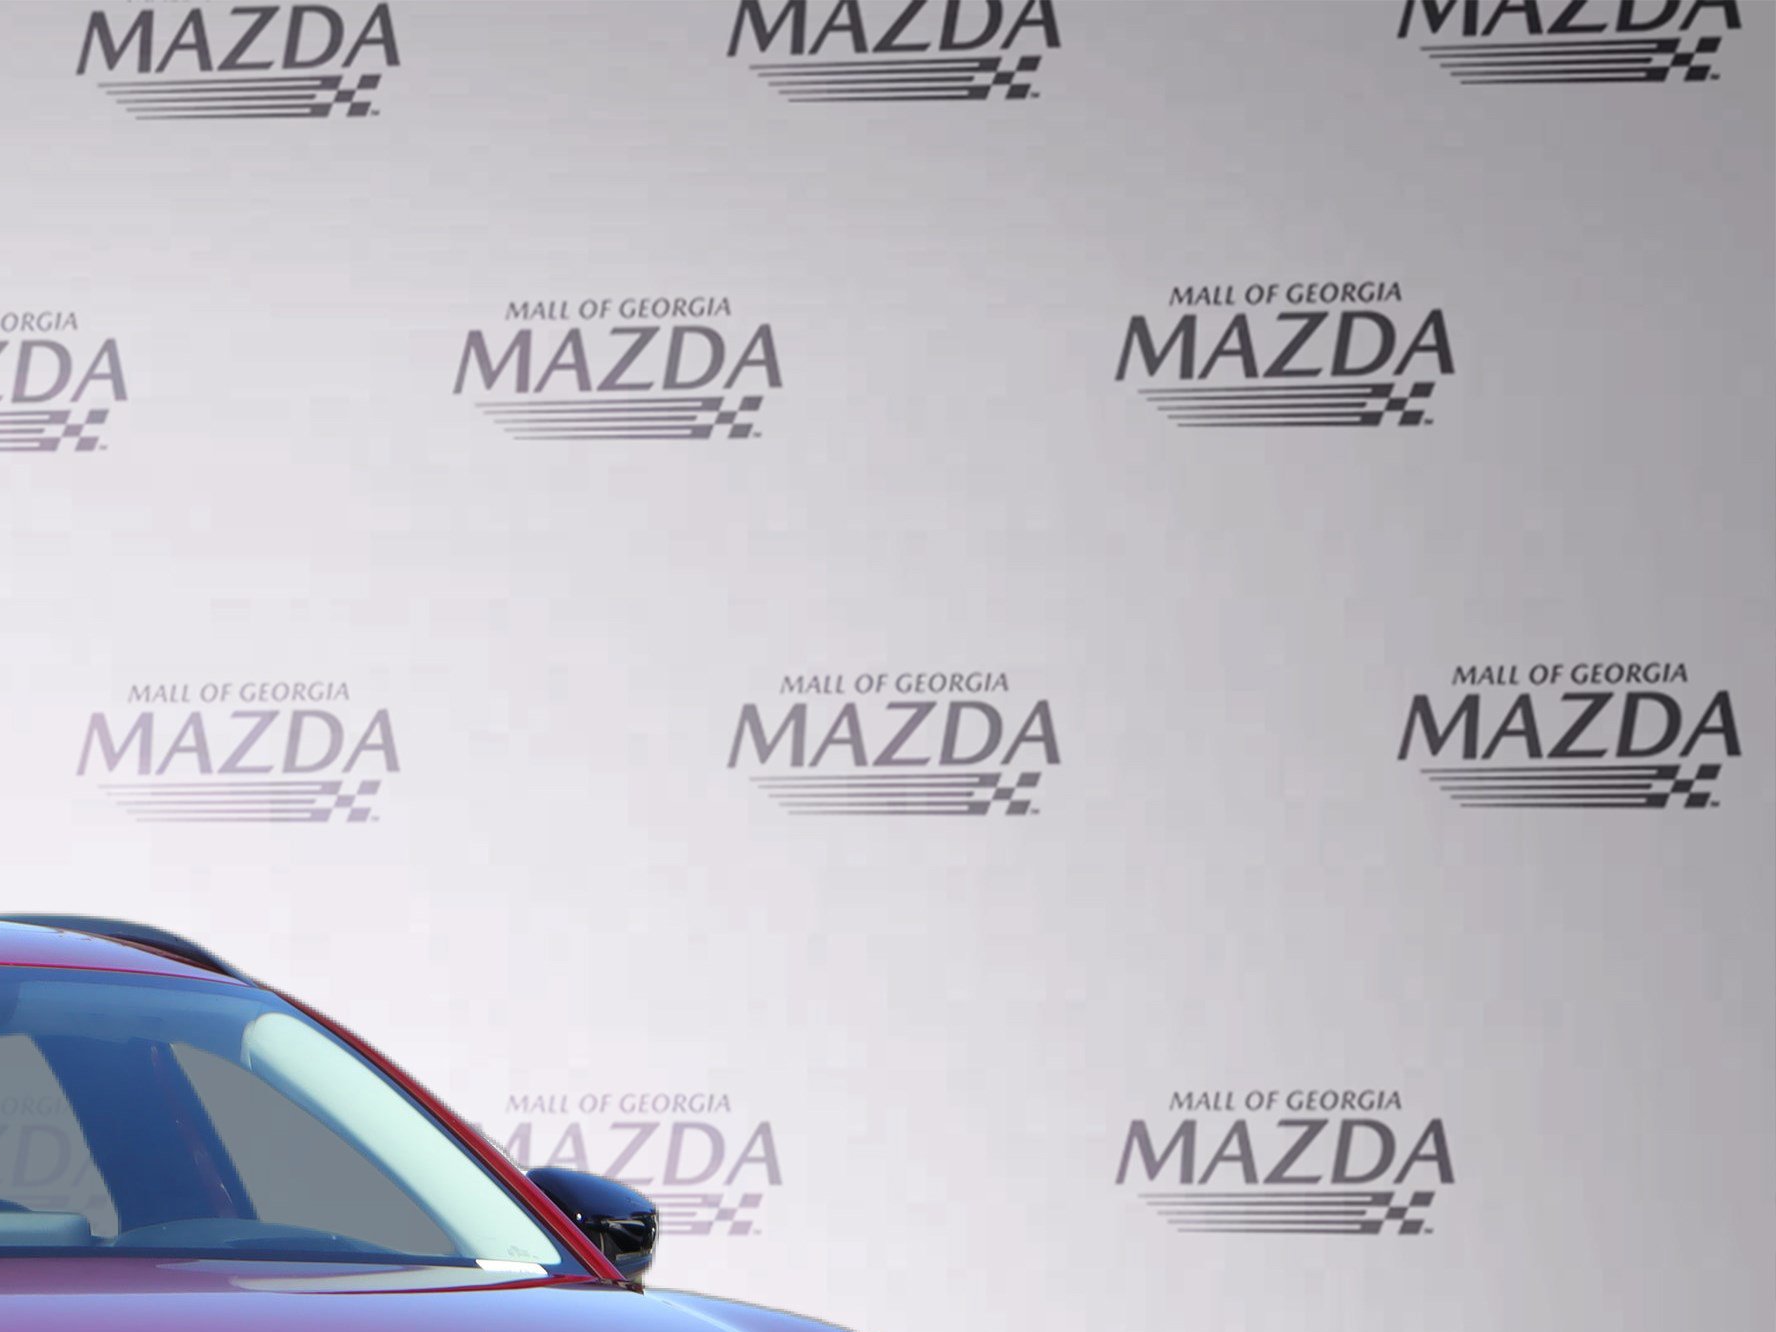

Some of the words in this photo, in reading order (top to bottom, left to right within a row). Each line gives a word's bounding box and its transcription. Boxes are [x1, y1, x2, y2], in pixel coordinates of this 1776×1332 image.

[76, 3, 400, 75] MAZDA
[727, 0, 1061, 57] MAZDA
[507, 301, 568, 320] MALL
[579, 299, 611, 320] OF
[619, 297, 731, 318] GEORGIA
[1170, 286, 1234, 305] MALL
[1245, 284, 1279, 305] OF
[1286, 281, 1402, 304] GEORGIA
[453, 324, 782, 394] MAZDA
[1115, 309, 1455, 381] MAZDA
[128, 684, 189, 703] MALL
[200, 683, 232, 703] OF
[239, 682, 349, 702] GEORGIA
[782, 675, 844, 694] MALL
[854, 674, 888, 694] OF
[895, 672, 1009, 693] GEORGIA
[1452, 665, 1518, 685] MALL
[1529, 664, 1563, 685] OF
[1571, 662, 1688, 684] GEORGIA
[77, 708, 400, 776] MAZDA
[727, 700, 1061, 768] MAZDA
[1398, 690, 1741, 760] MAZDA
[507, 1093, 568, 1112] MALL
[579, 1093, 612, 1112] OF
[619, 1093, 731, 1113] GEORGIA
[1170, 1091, 1234, 1111] MALL
[1245, 1090, 1279, 1111] OF
[1286, 1090, 1402, 1111] GEORGIA
[1116, 1118, 1455, 1184] MAZDA
